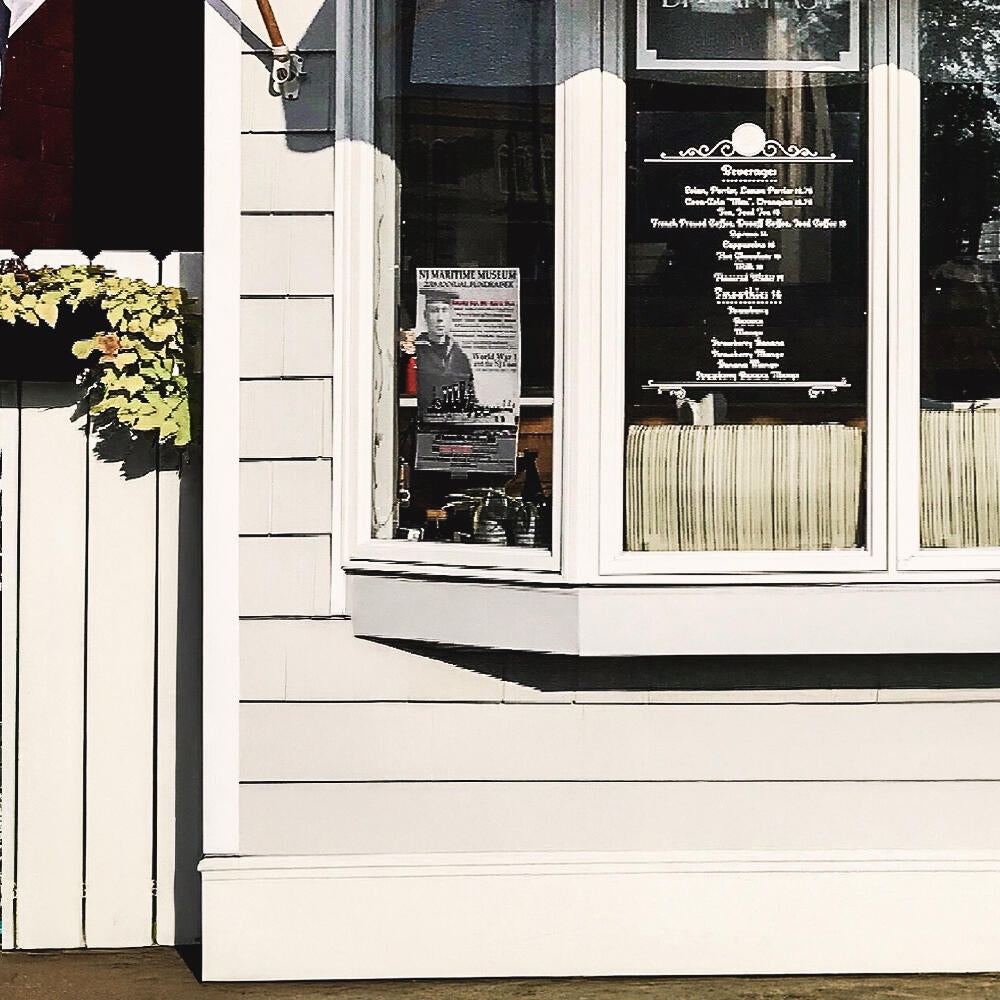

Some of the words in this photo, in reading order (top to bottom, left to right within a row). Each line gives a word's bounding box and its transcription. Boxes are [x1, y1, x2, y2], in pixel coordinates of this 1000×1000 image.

[721, 164, 777, 178] Beverages
[431, 269, 476, 280] MARITIME
[478, 269, 517, 280] MUSEUM
